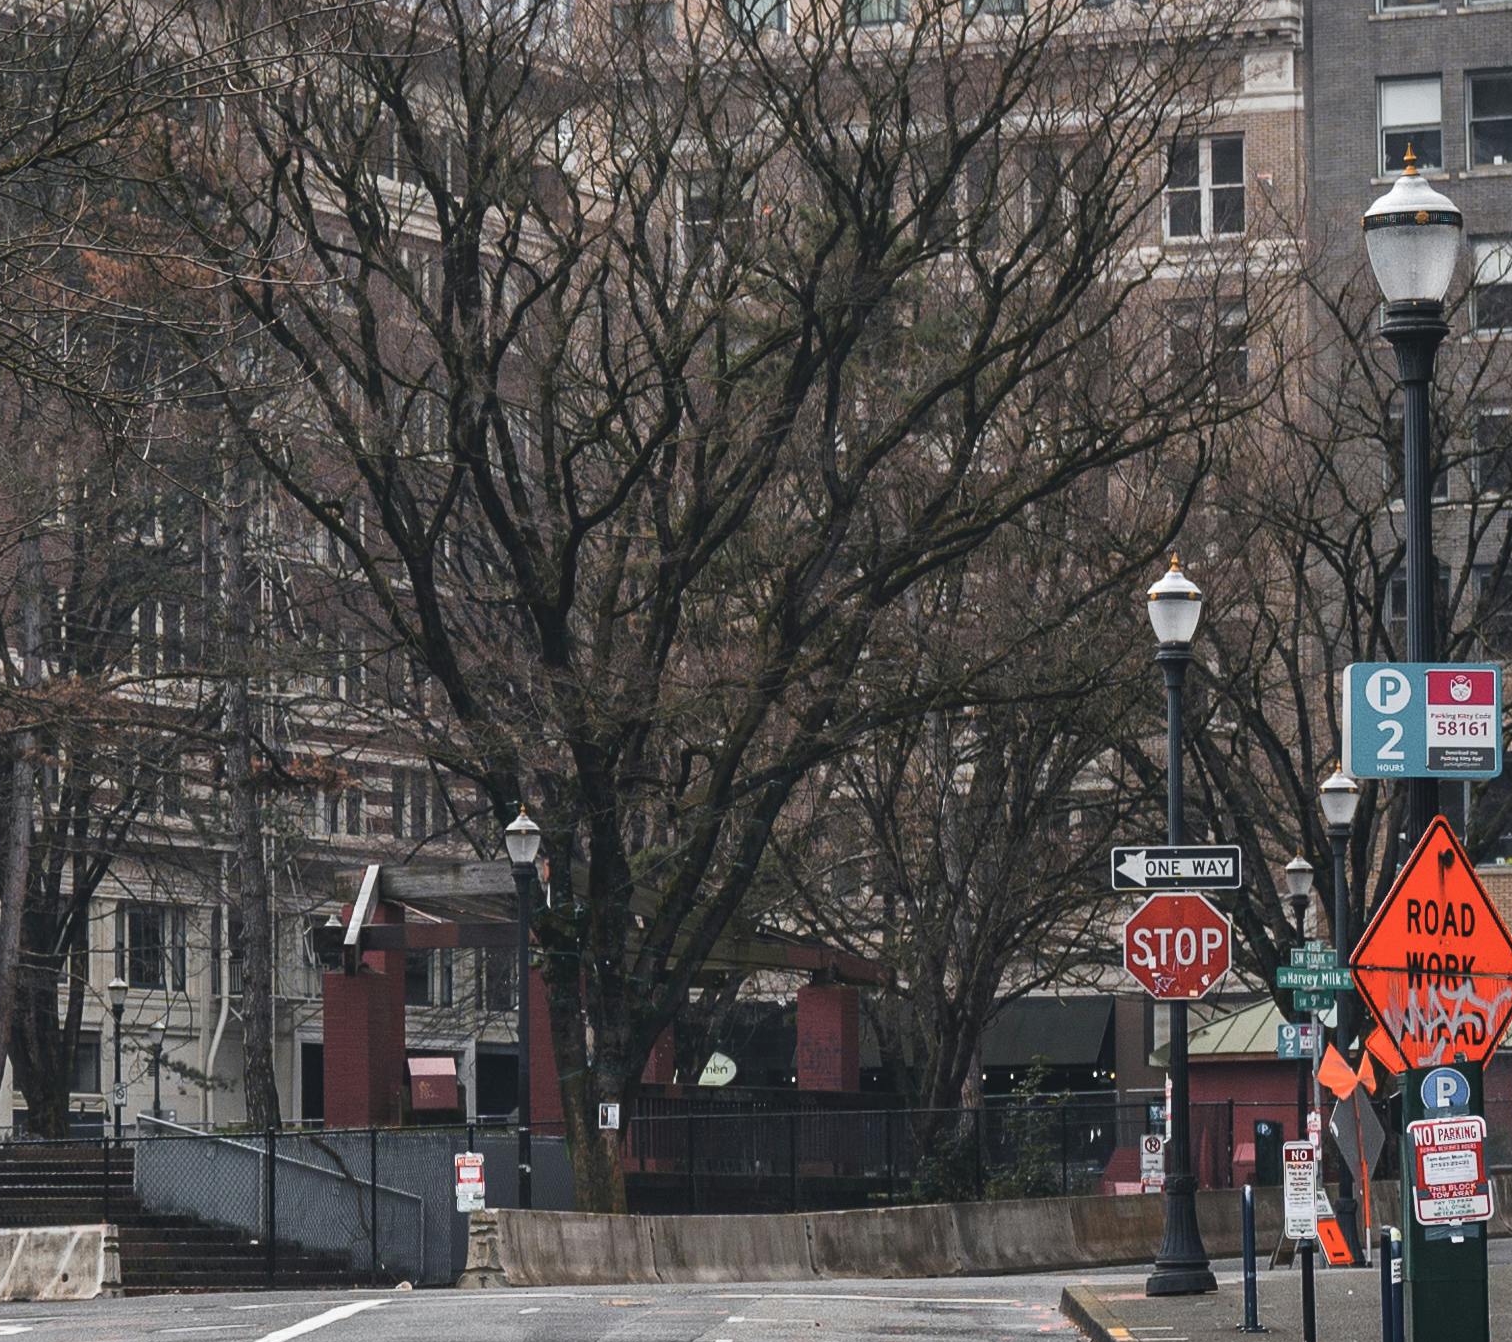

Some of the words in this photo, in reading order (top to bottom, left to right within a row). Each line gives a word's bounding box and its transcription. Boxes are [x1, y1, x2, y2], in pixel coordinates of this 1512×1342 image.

[1380, 676, 1401, 707] P
[1437, 721, 1487, 736] 58161
[1377, 720, 1405, 759] 2
[1377, 764, 1405, 772] HOURS
[1146, 860, 1181, 876] ONE
[1192, 860, 1229, 875] WAY
[1407, 899, 1476, 937] ROAD
[1131, 927, 1223, 967] STOP
[1294, 953, 1304, 964] SW
[1288, 972, 1318, 987] Harvey
[1322, 972, 1341, 985] Milk
[1406, 951, 1476, 994] WORK
[1285, 1041, 1294, 1054] 2
[1437, 1077, 1457, 1107] P
[1261, 1123, 1268, 1134] P
[1413, 1125, 1432, 1147] NO
[1438, 1125, 1477, 1141] PARKING
[1291, 1150, 1308, 1161] NO
[1449, 1183, 1477, 1191] BLOCK
